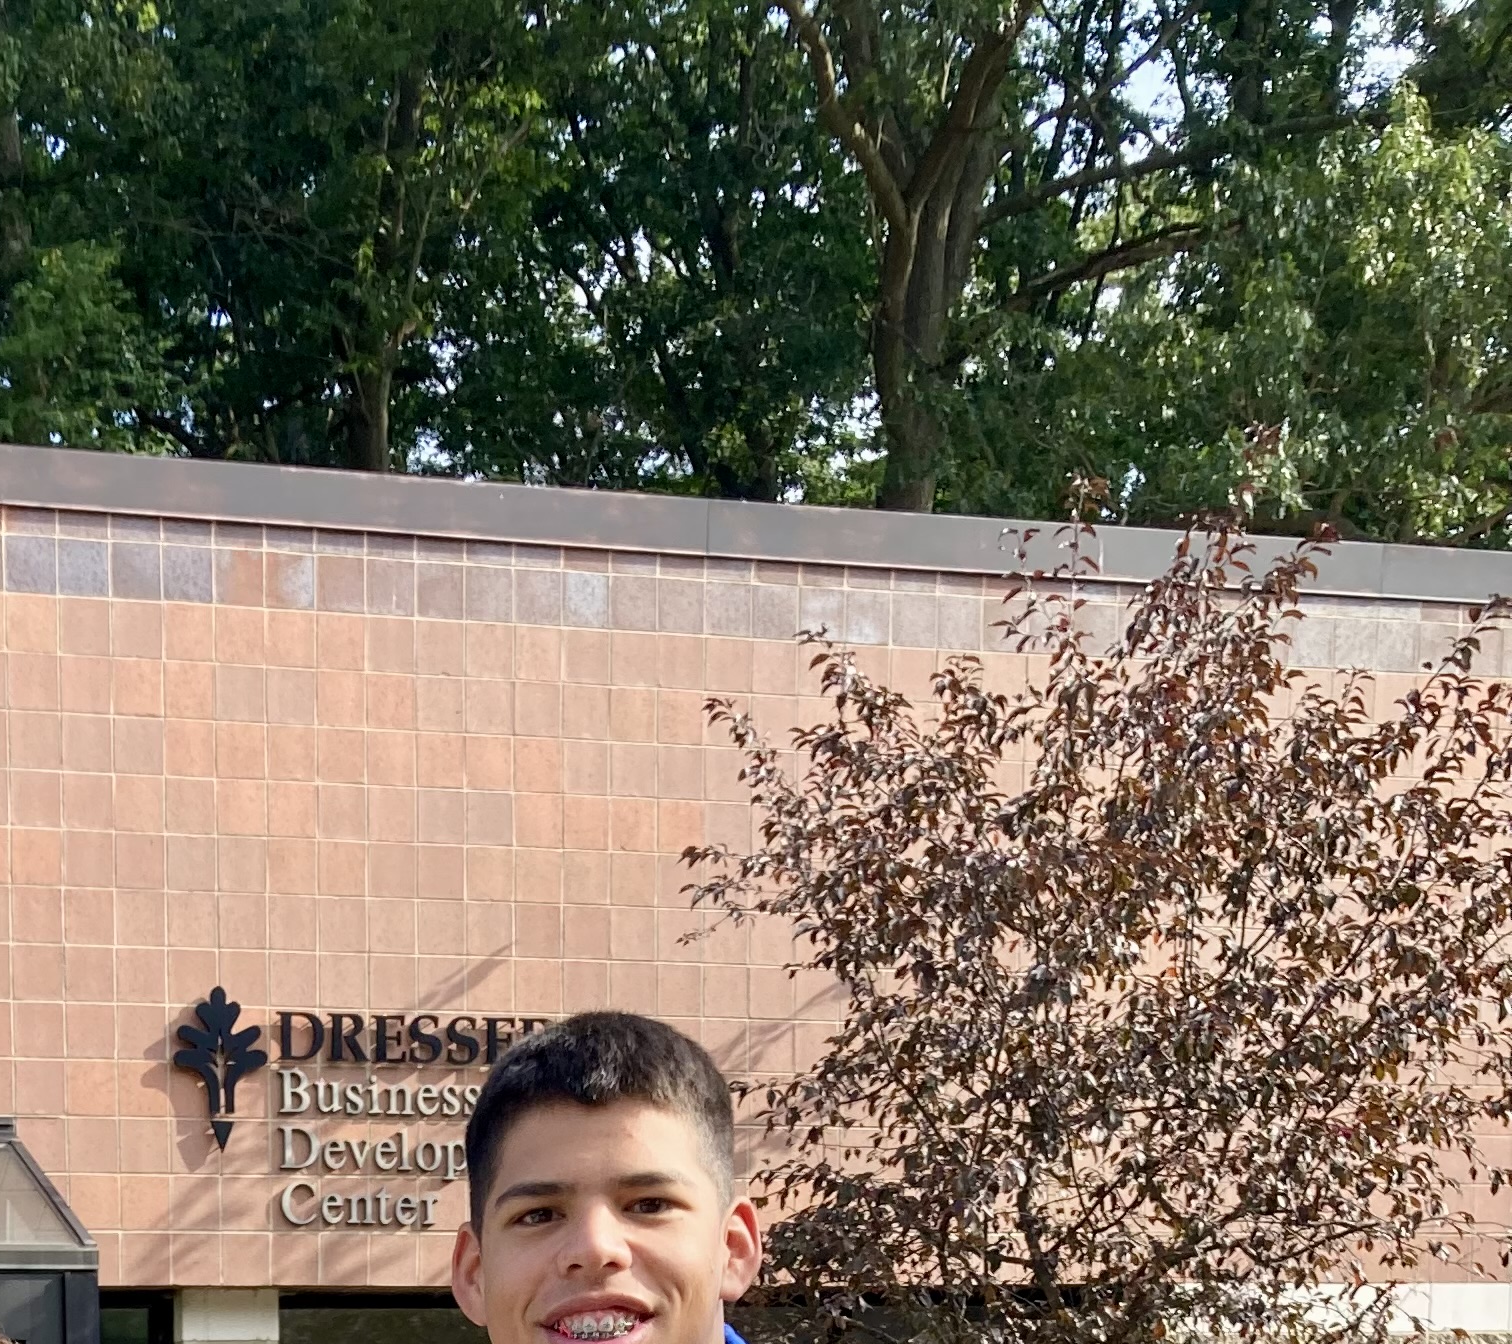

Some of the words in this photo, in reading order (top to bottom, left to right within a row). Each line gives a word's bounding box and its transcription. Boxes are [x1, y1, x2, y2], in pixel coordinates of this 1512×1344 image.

[277, 1068, 481, 1116] Business
[278, 1125, 467, 1180] Develop
[281, 1182, 438, 1226] Center
